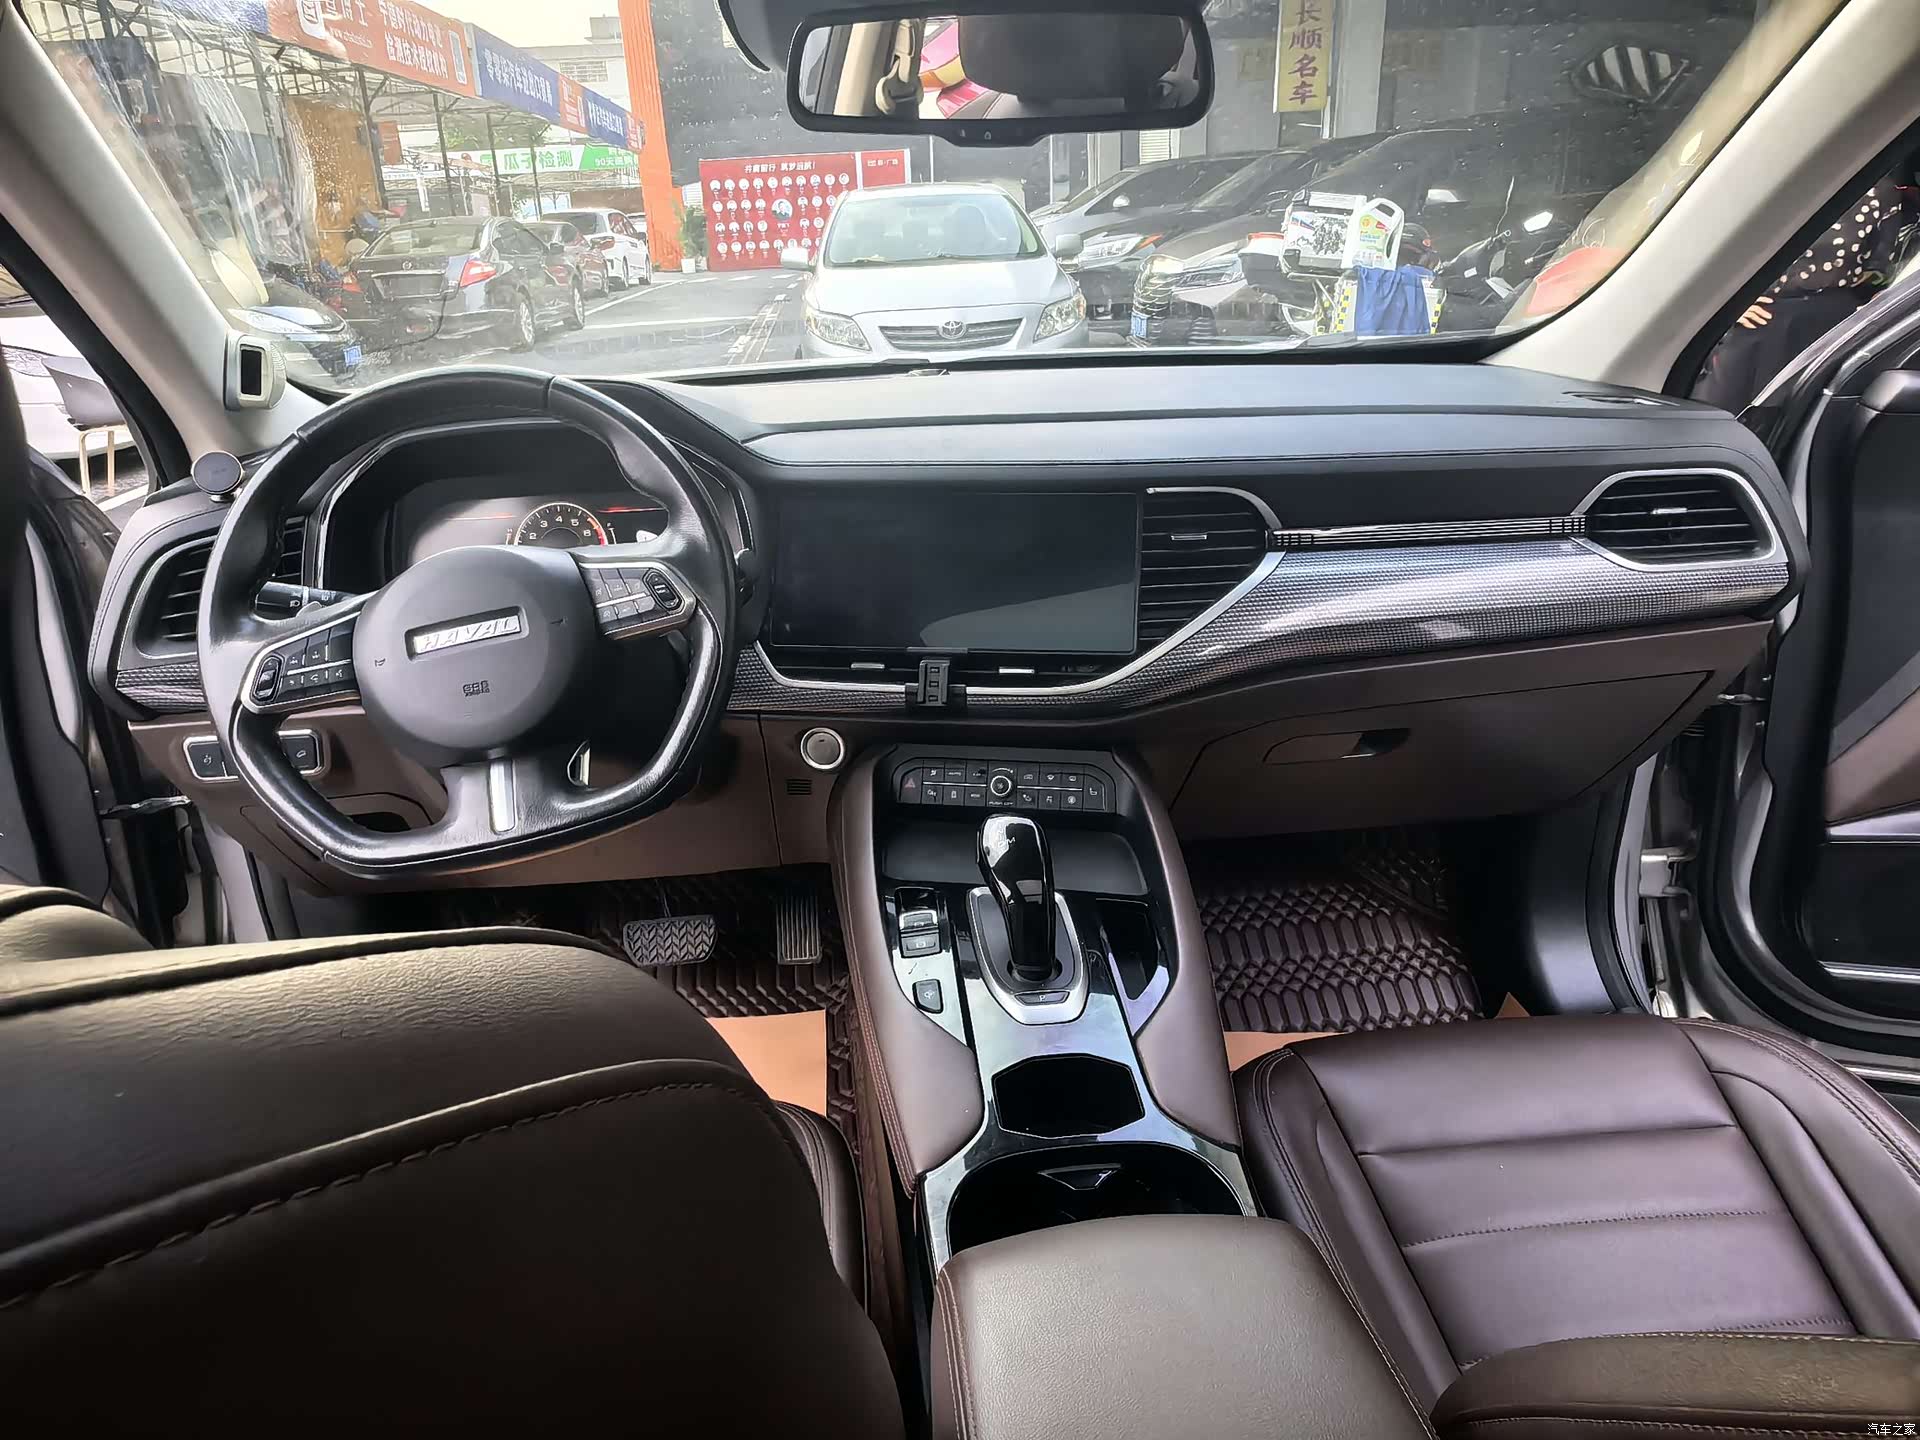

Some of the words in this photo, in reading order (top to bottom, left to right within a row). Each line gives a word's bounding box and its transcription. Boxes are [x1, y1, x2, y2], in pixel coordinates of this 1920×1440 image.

[556, 515, 563, 523] 4
[571, 518, 579, 527] 5
[540, 520, 548, 528] 3
[529, 532, 537, 540] 2
[421, 618, 518, 652] HAVAL
